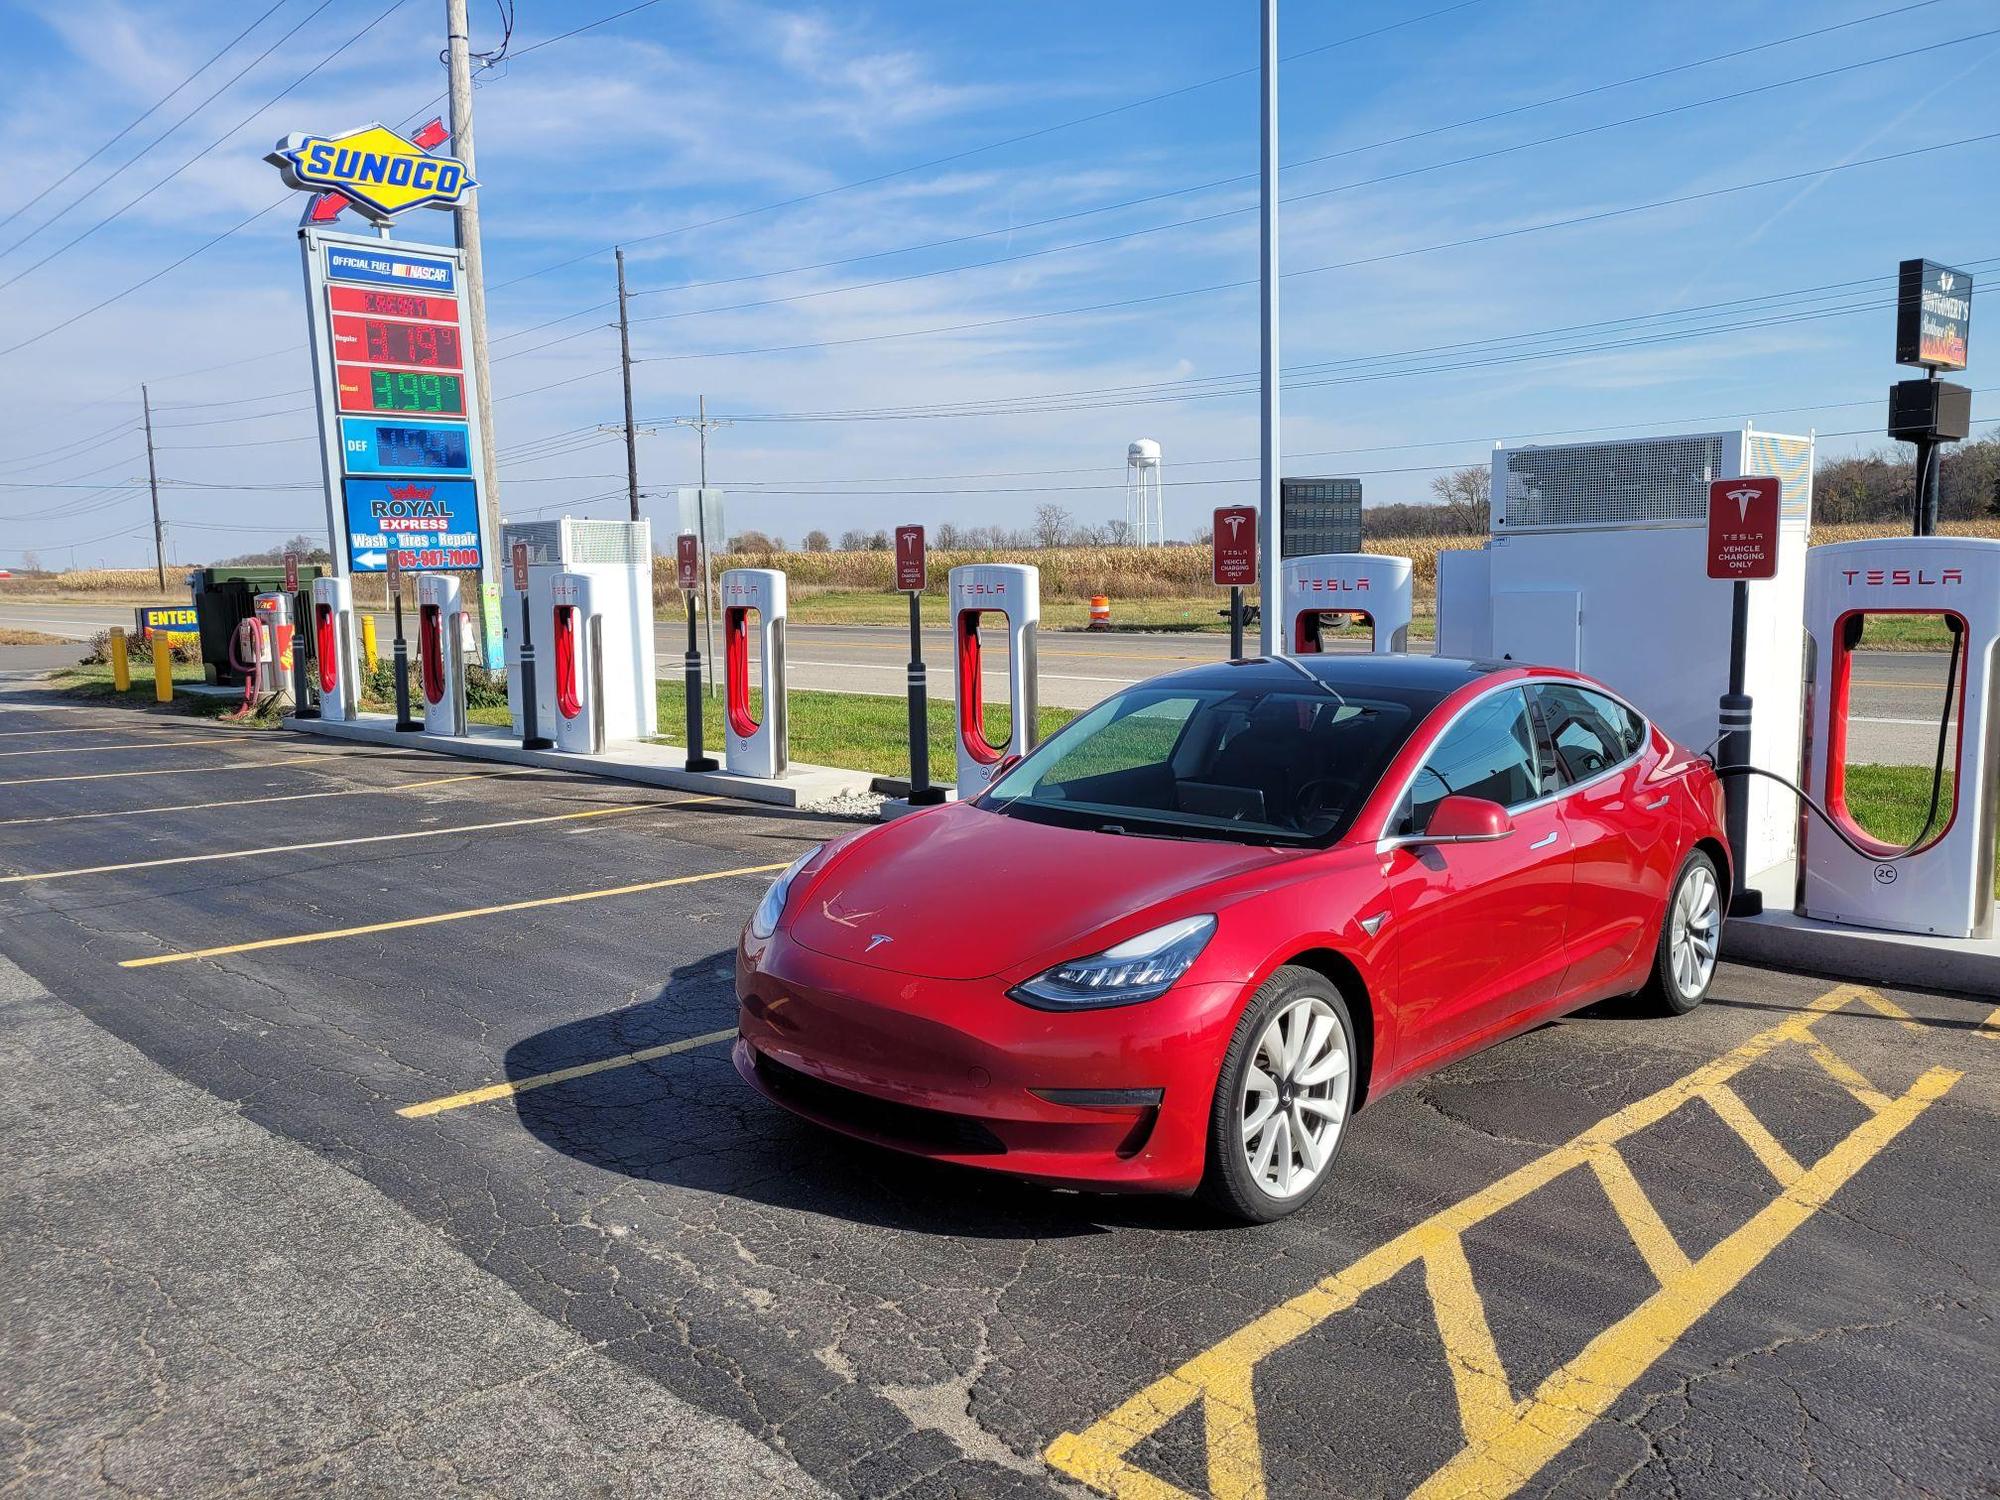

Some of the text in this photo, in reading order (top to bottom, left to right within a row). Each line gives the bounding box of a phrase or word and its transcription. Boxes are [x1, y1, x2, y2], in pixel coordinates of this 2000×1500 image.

[307, 145, 461, 193] SUNOCO
[332, 255, 449, 282] OFFICIAL FUEL NASCAR
[335, 334, 358, 342] Regular
[347, 439, 368, 452] DEF
[370, 500, 454, 517] ROYAL
[379, 519, 449, 530] EXPRESS
[352, 532, 477, 548] Wash Tires Repair
[1721, 533, 1763, 541] TESLA
[1723, 545, 1761, 553] VEHICLE
[399, 549, 479, 567] 65-987-7000
[1718, 553, 1765, 561] CHARGING
[1298, 577, 1370, 591] TESLA
[1842, 569, 1962, 586] TESLA
[725, 585, 758, 594] TESLA
[958, 584, 1005, 594] TESLA
[256, 601, 273, 609] Vac
[148, 610, 197, 626] ENTER
